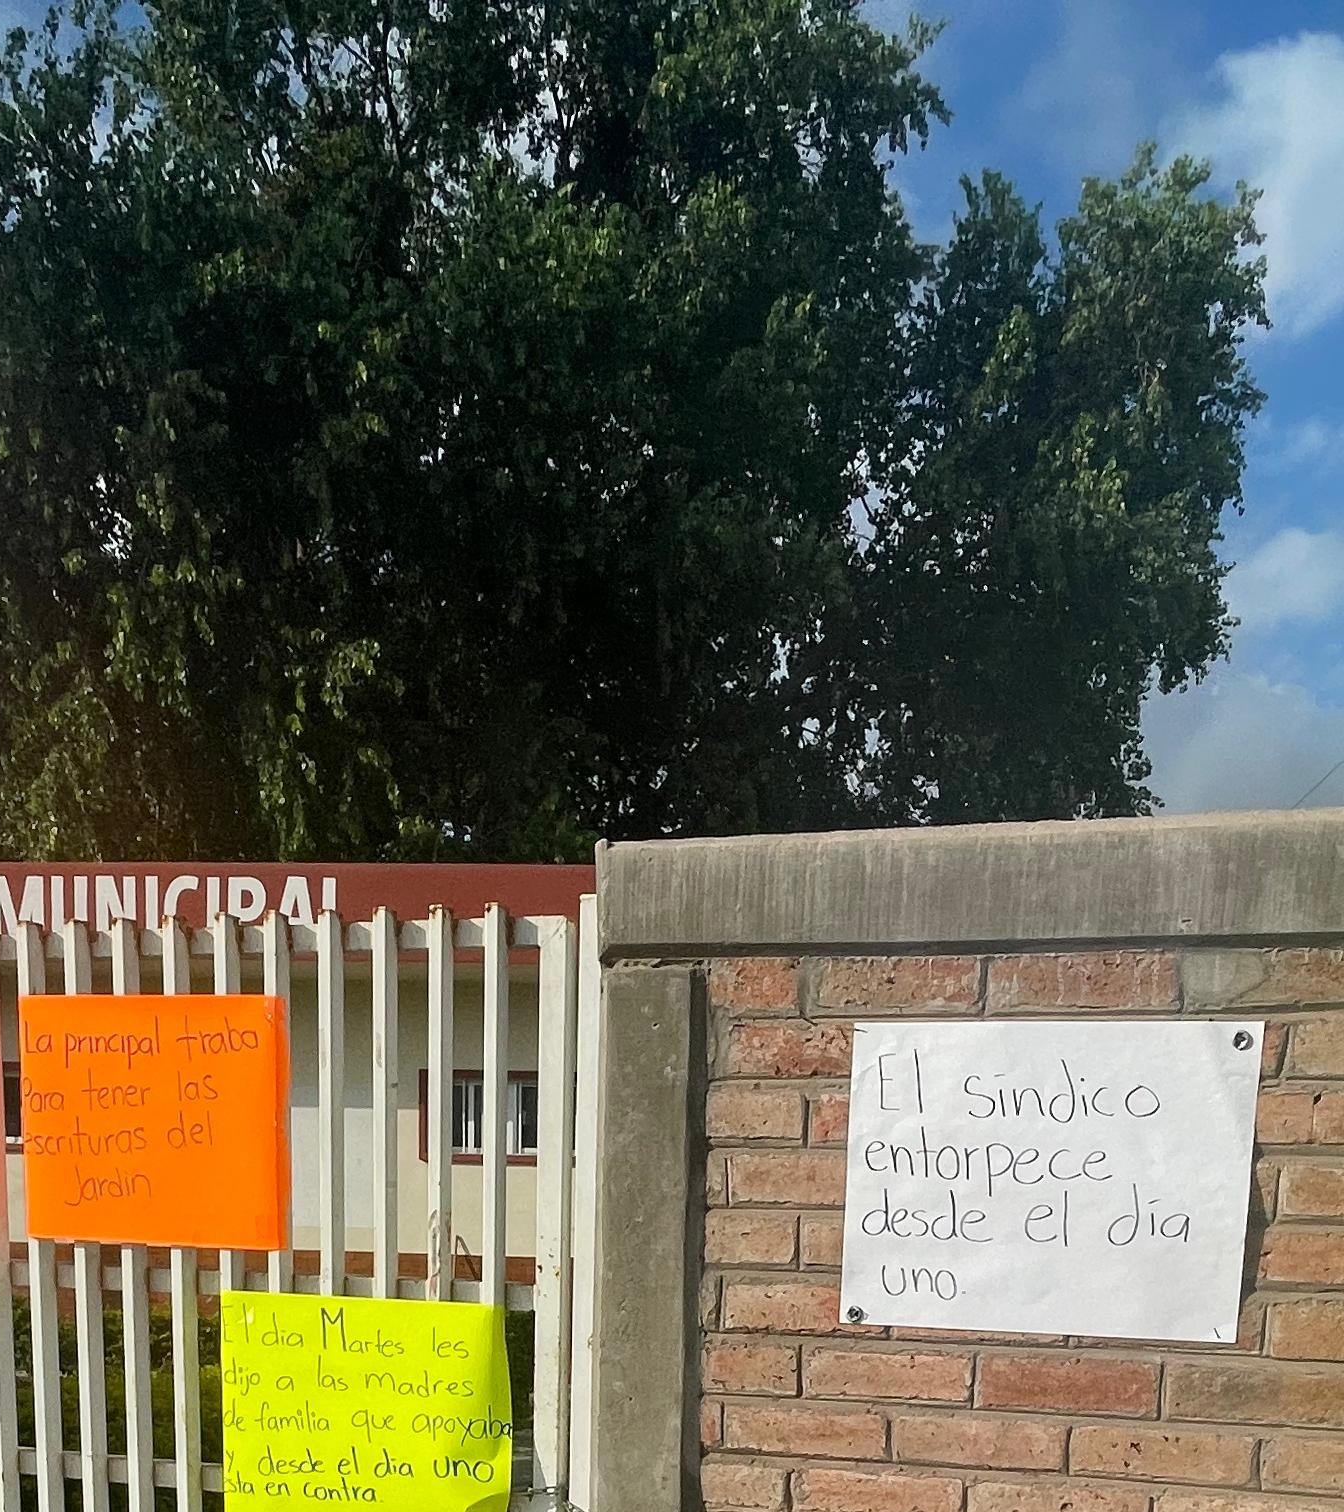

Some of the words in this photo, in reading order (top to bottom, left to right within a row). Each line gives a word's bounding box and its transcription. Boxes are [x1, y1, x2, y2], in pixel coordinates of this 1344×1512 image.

[25, 1020, 53, 1053] La
[64, 1015, 160, 1070] principal
[81, 1067, 151, 1111] tener
[177, 1070, 218, 1101] las
[879, 1048, 923, 1114] El
[167, 1110, 213, 1149] del
[864, 1125, 1114, 1197] entorpece
[861, 1188, 994, 1242] desde
[1024, 1190, 1069, 1247] el
[221, 1302, 249, 1344] El
[320, 1307, 405, 1358] Martes
[432, 1327, 470, 1358] les
[223, 1357, 261, 1396] dijo
[275, 1375, 295, 1392] a
[317, 1355, 349, 1391] las
[365, 1370, 474, 1398] madres
[223, 1398, 246, 1432] de
[254, 1400, 330, 1434] familia
[351, 1409, 397, 1443] que
[257, 1445, 326, 1477] desde
[337, 1446, 360, 1475] el
[433, 1456, 495, 1483] uno
[265, 1481, 291, 1497] en
